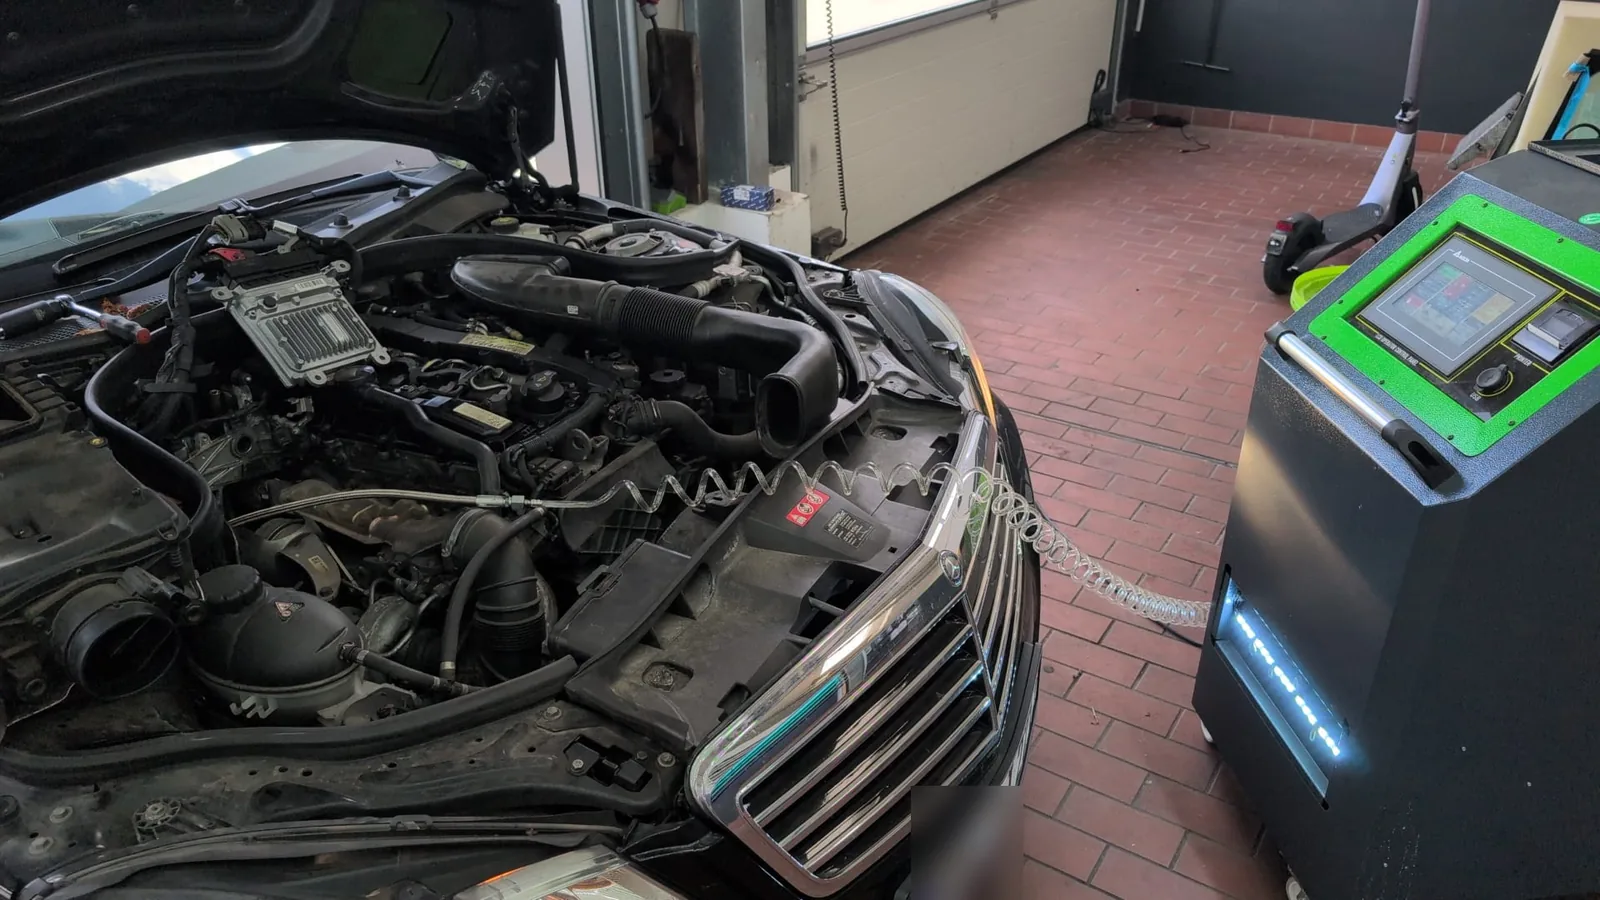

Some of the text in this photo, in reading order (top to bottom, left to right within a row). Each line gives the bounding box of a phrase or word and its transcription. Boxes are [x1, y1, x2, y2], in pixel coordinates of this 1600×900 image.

[1394, 346, 1410, 360] CONTROL
[1513, 353, 1533, 367] PRINTER
[1469, 391, 1482, 402] USB
